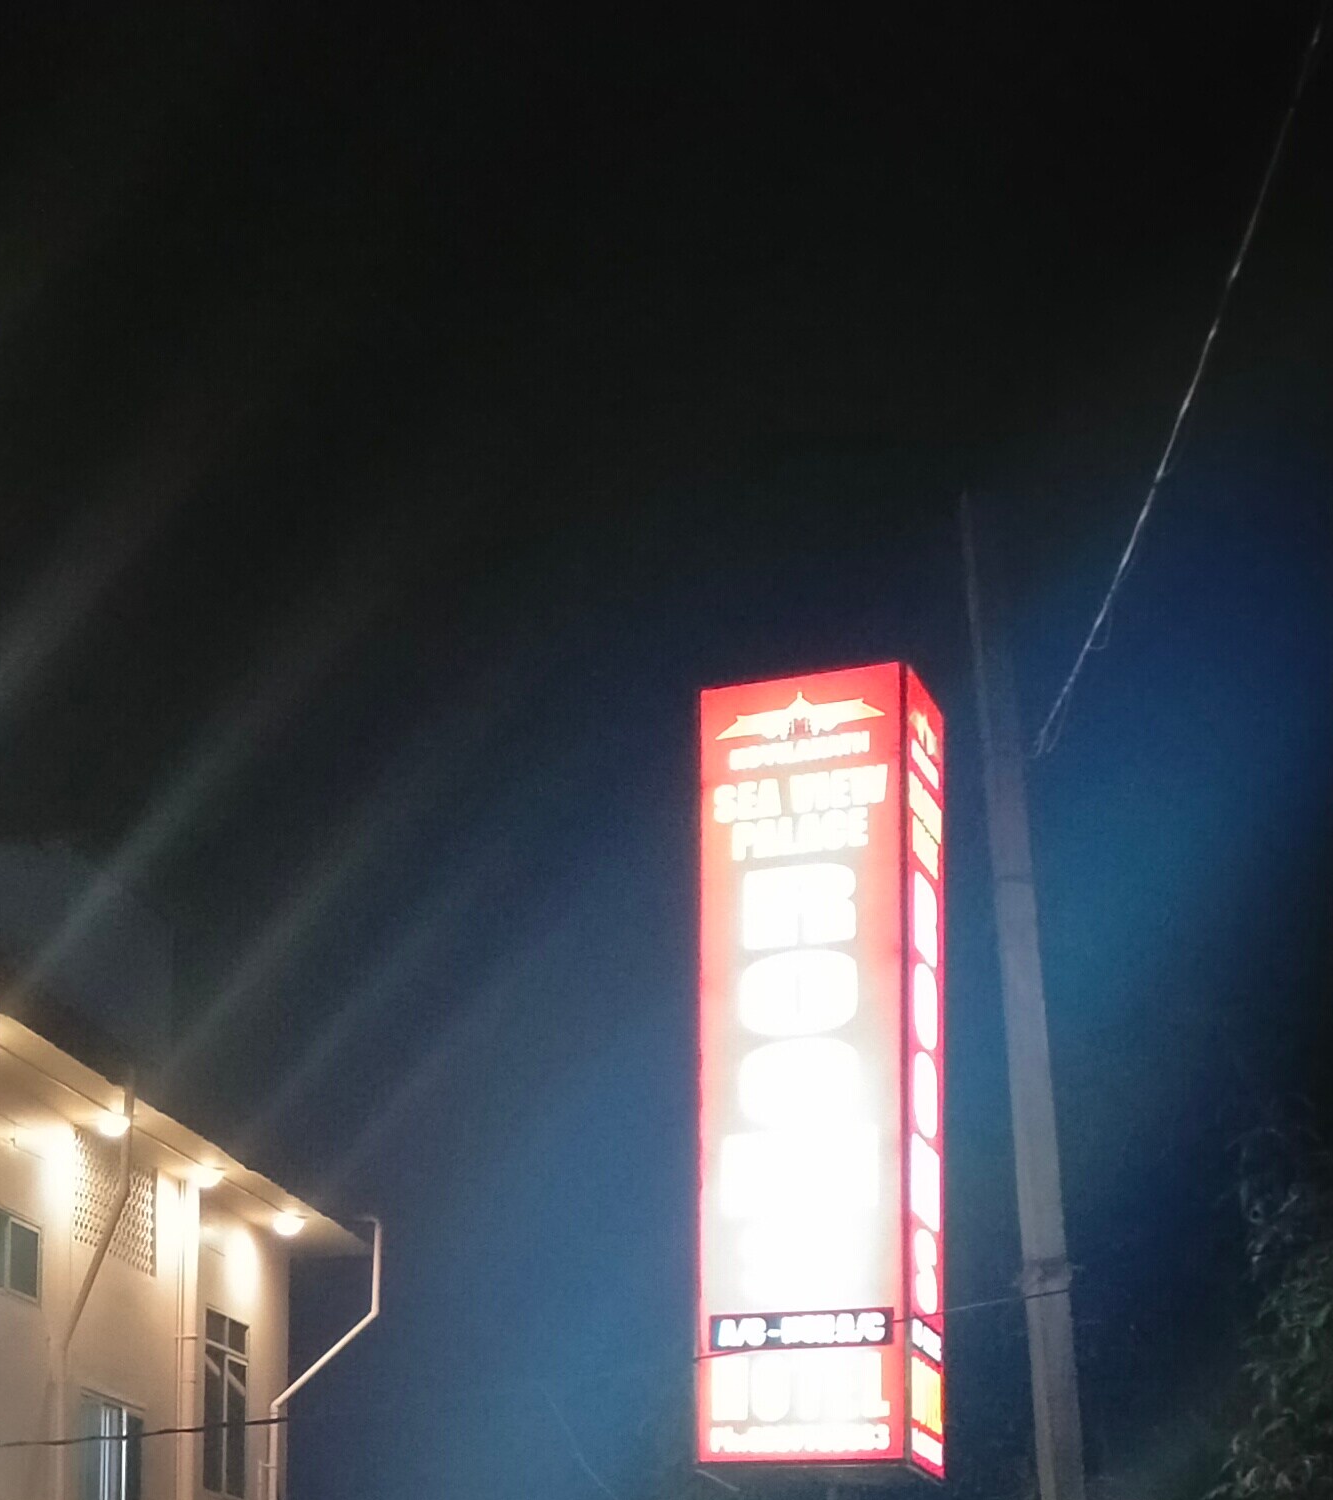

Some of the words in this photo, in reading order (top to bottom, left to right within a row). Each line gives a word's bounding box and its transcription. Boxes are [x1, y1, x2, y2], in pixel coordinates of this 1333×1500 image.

[713, 778, 782, 823] SEA
[789, 764, 888, 814] VIEW
[732, 807, 869, 861] PALACE
